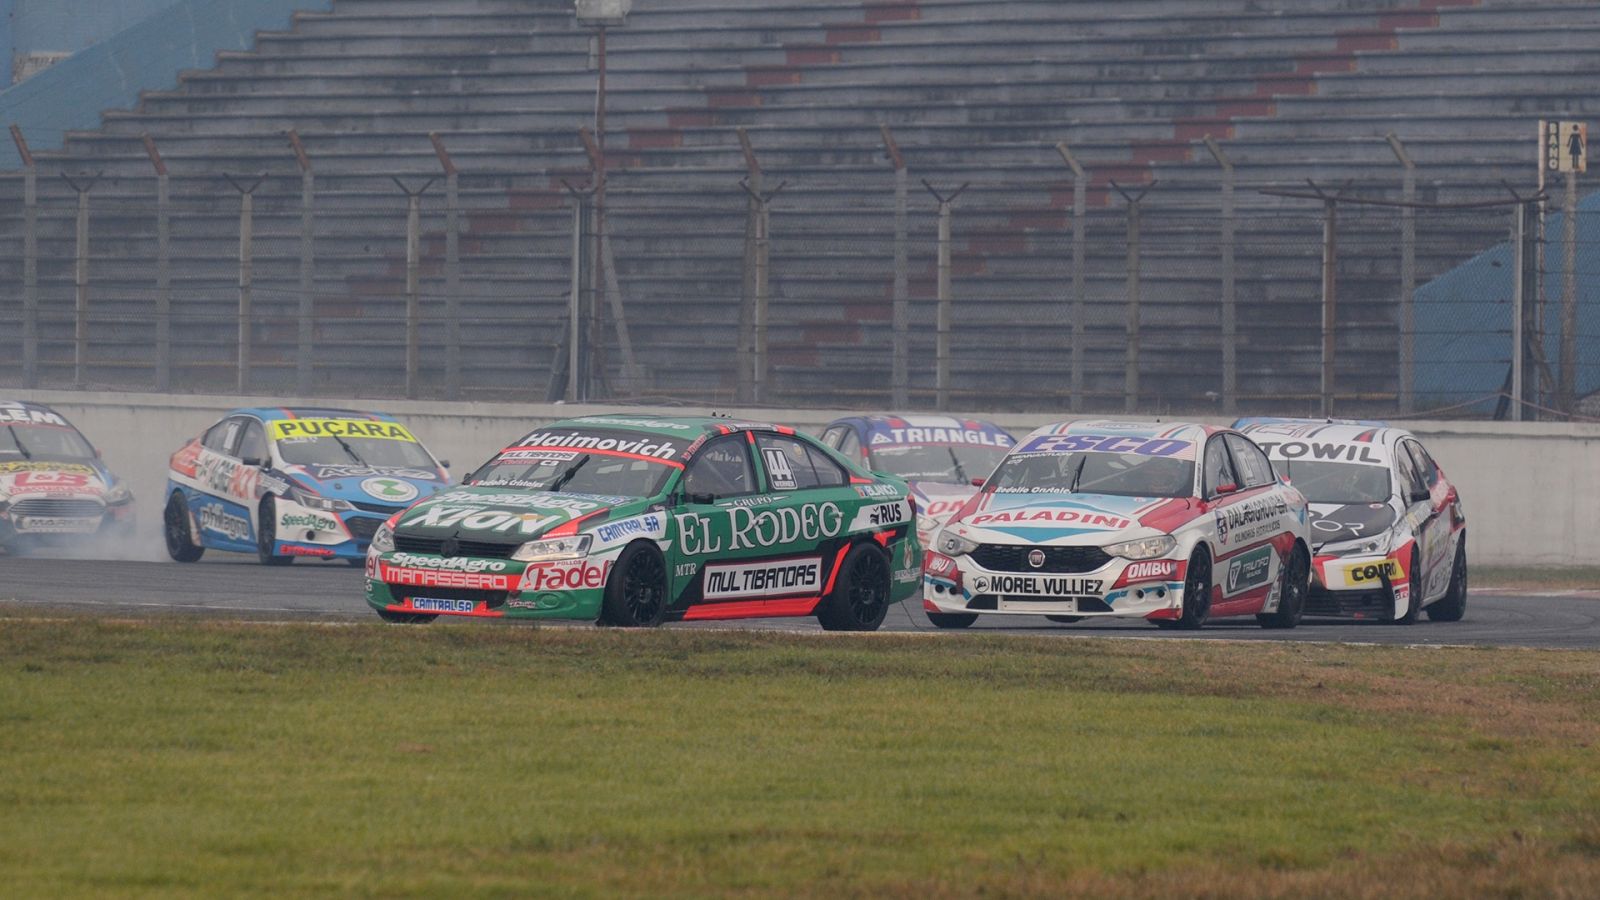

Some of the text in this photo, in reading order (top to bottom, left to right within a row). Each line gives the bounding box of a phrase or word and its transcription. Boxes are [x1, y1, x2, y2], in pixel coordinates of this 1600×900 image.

[279, 421, 409, 440] PUCARA
[891, 428, 1010, 448] TRIANGLE
[520, 432, 677, 459] Haimovich
[1018, 435, 1192, 456] ESCO
[1259, 441, 1382, 464] TOWIL
[766, 450, 793, 481] 44
[733, 496, 772, 508] GRUPO
[281, 513, 337, 531] SpeedAgro
[880, 503, 902, 523] RUS
[971, 511, 1130, 529] PALADINI
[675, 501, 844, 556] EL RODEO
[389, 551, 507, 573] SpeedAgro
[676, 562, 697, 577] MTR
[1127, 561, 1172, 578] OMBU
[386, 567, 508, 589] MANASSERO
[526, 559, 609, 591] Fadel
[707, 564, 817, 593] MULTIBANDAS
[990, 575, 1104, 596] MOREL VULLIEZ
